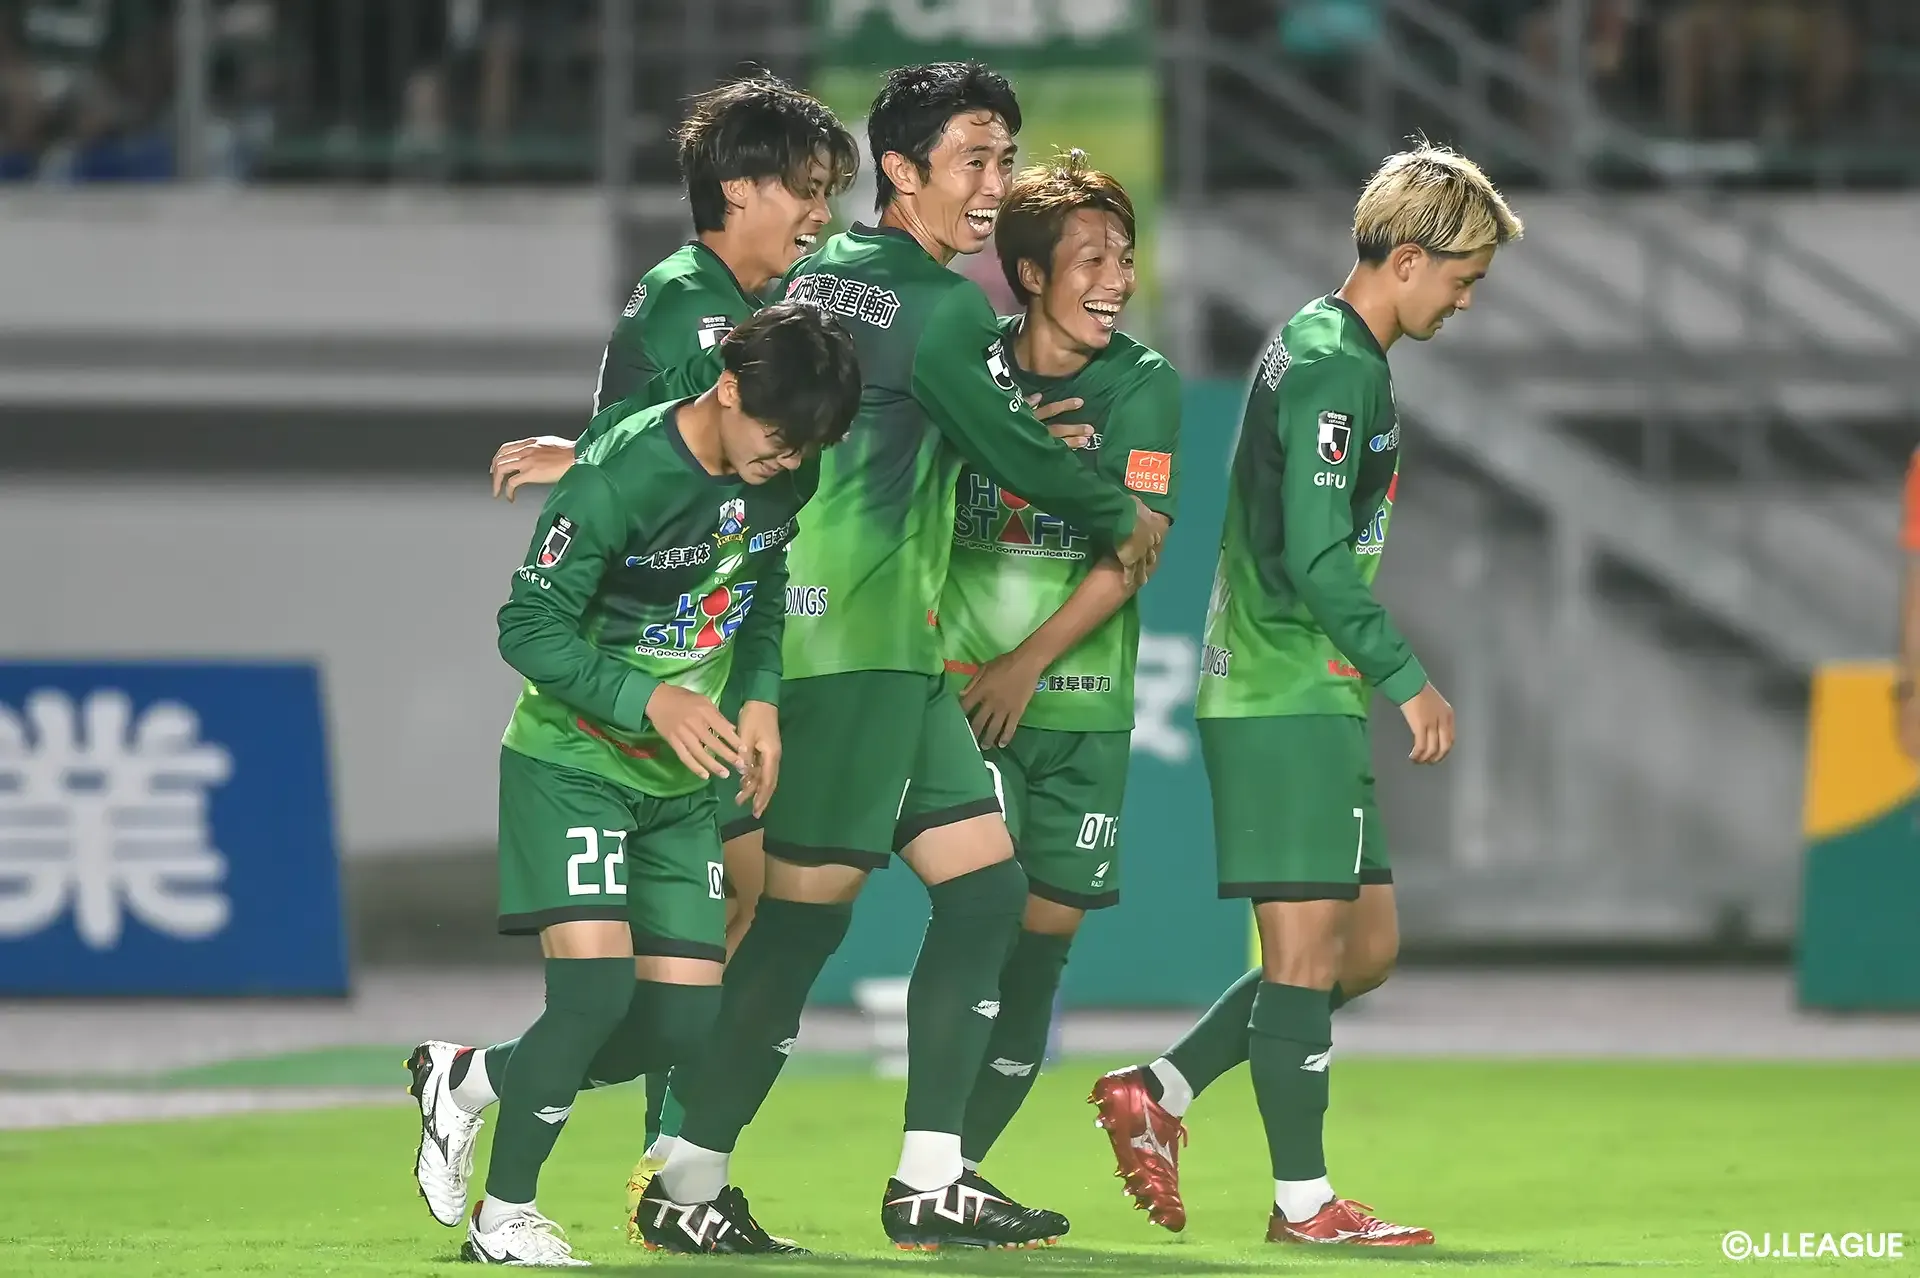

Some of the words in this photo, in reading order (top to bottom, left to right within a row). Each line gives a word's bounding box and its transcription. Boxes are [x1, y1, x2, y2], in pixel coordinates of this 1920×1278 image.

[1127, 480, 1165, 491] HOUSE
[1128, 471, 1167, 482] CHECK
[1313, 471, 1347, 489] GIFU
[651, 542, 711, 569] 岐阜車体
[995, 546, 1087, 561] communication
[519, 567, 552, 590] GIFU
[635, 645, 654, 656] for
[655, 650, 687, 659] good
[1048, 674, 1113, 693] 岐阜電力
[565, 826, 628, 896] 22
